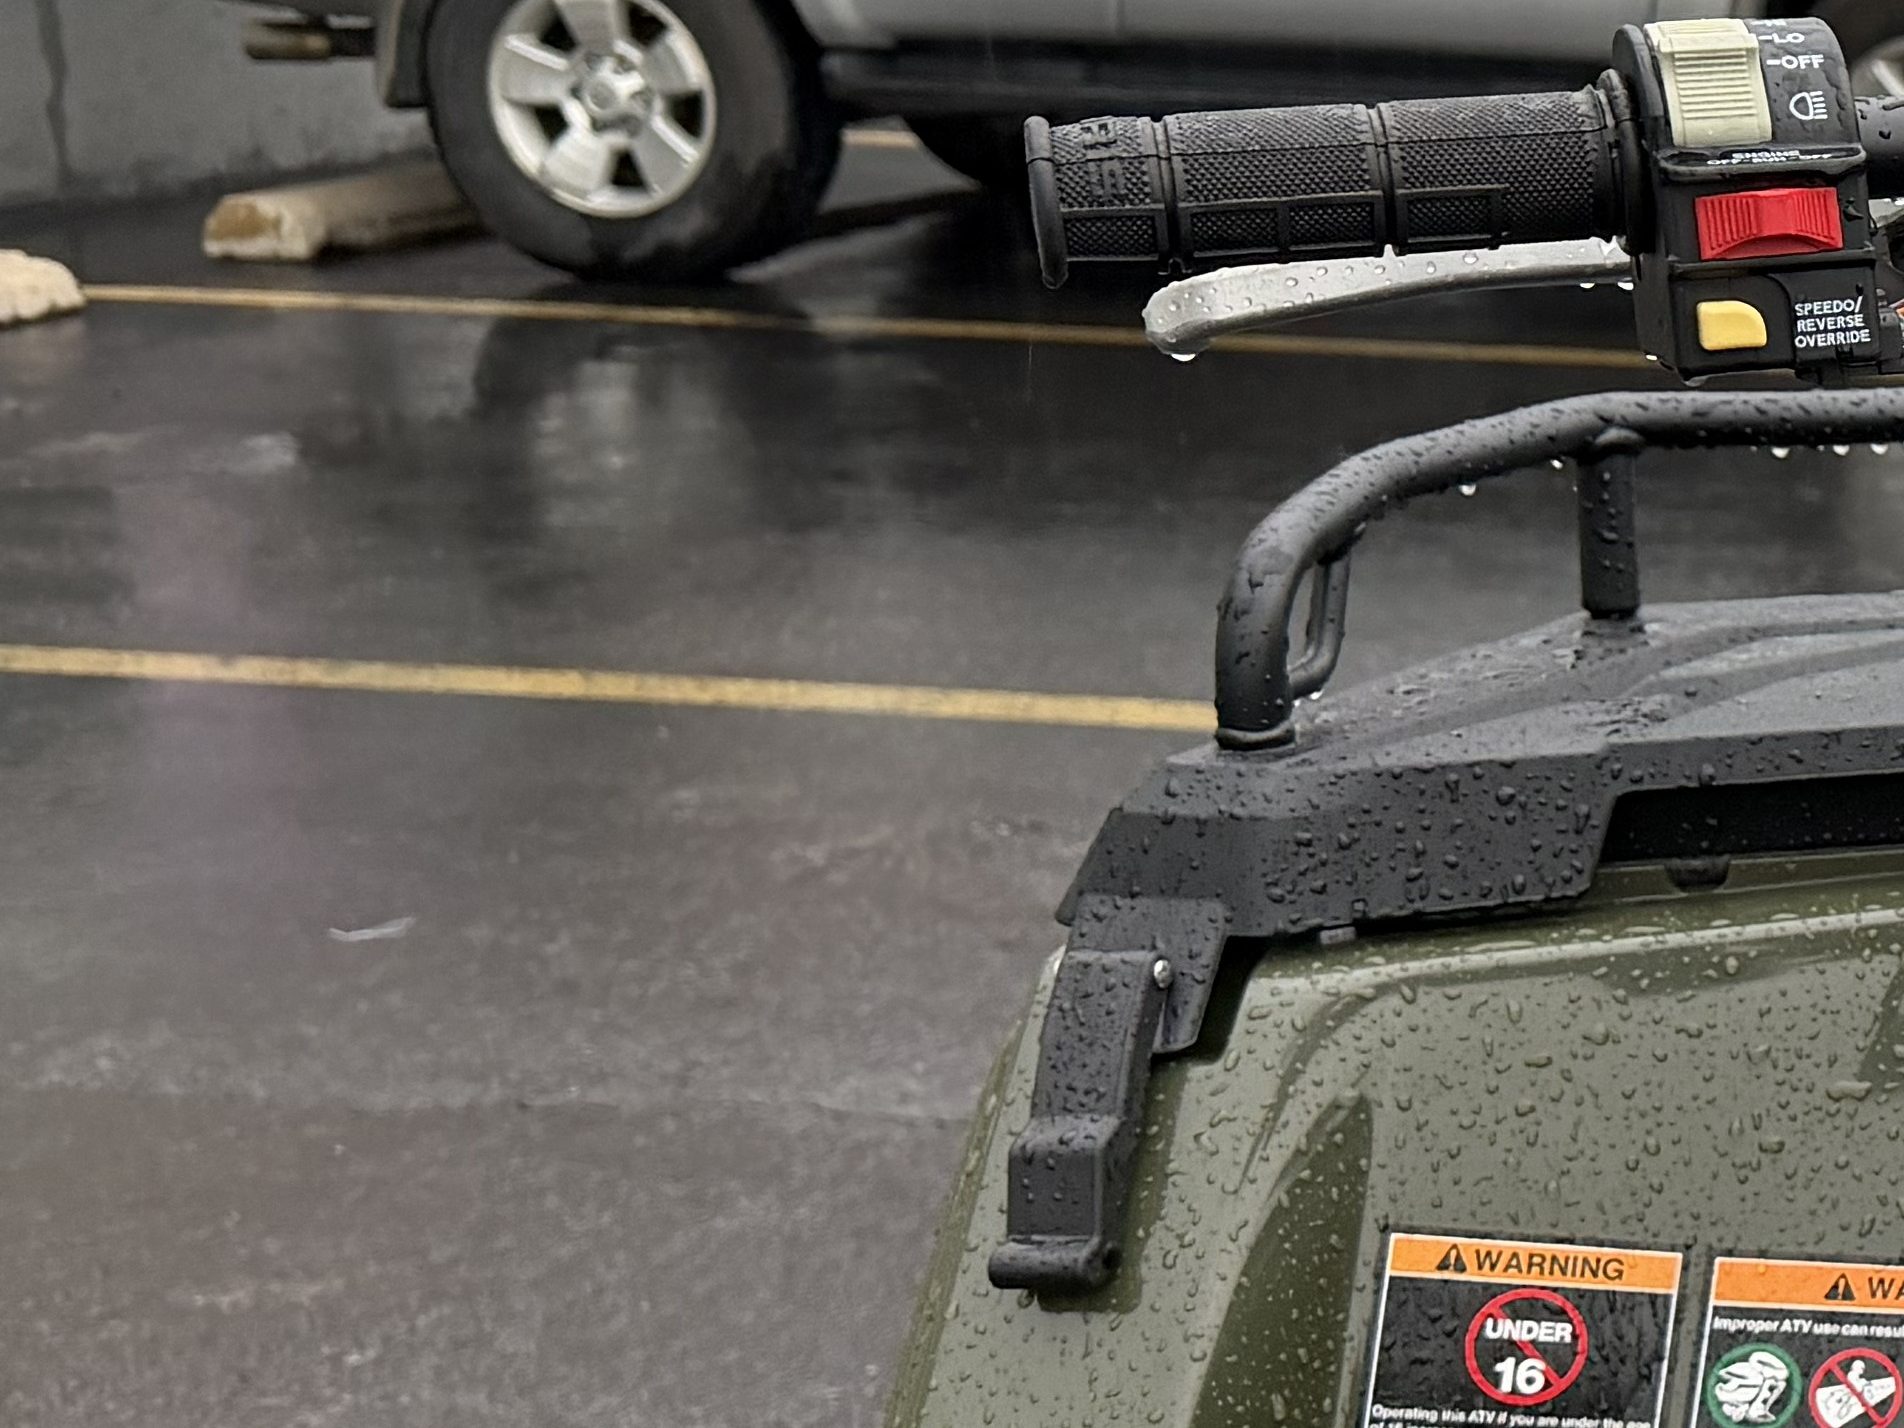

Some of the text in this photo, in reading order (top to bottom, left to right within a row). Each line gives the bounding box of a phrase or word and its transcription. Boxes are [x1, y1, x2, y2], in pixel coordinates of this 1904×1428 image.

[1795, 295, 1863, 317] SPEEDO/
[1796, 314, 1865, 332] REVERSE
[1794, 329, 1872, 348] OVERRIDE
[1472, 1248, 1625, 1281] WARNING
[1483, 1317, 1573, 1344] UNDER
[1713, 1315, 1779, 1332] Improper
[1780, 1319, 1811, 1331] ATV
[1812, 1323, 1839, 1332] use
[1841, 1324, 1868, 1334] can
[1491, 1355, 1548, 1395] 16
[1370, 1404, 1439, 1422] Operating
[1439, 1407, 1466, 1421] this
[1467, 1409, 1495, 1422] ATV
[1496, 1411, 1507, 1423] if
[1507, 1414, 1534, 1427] you
[1535, 1416, 1559, 1426] are
[1560, 1414, 1601, 1428] under
